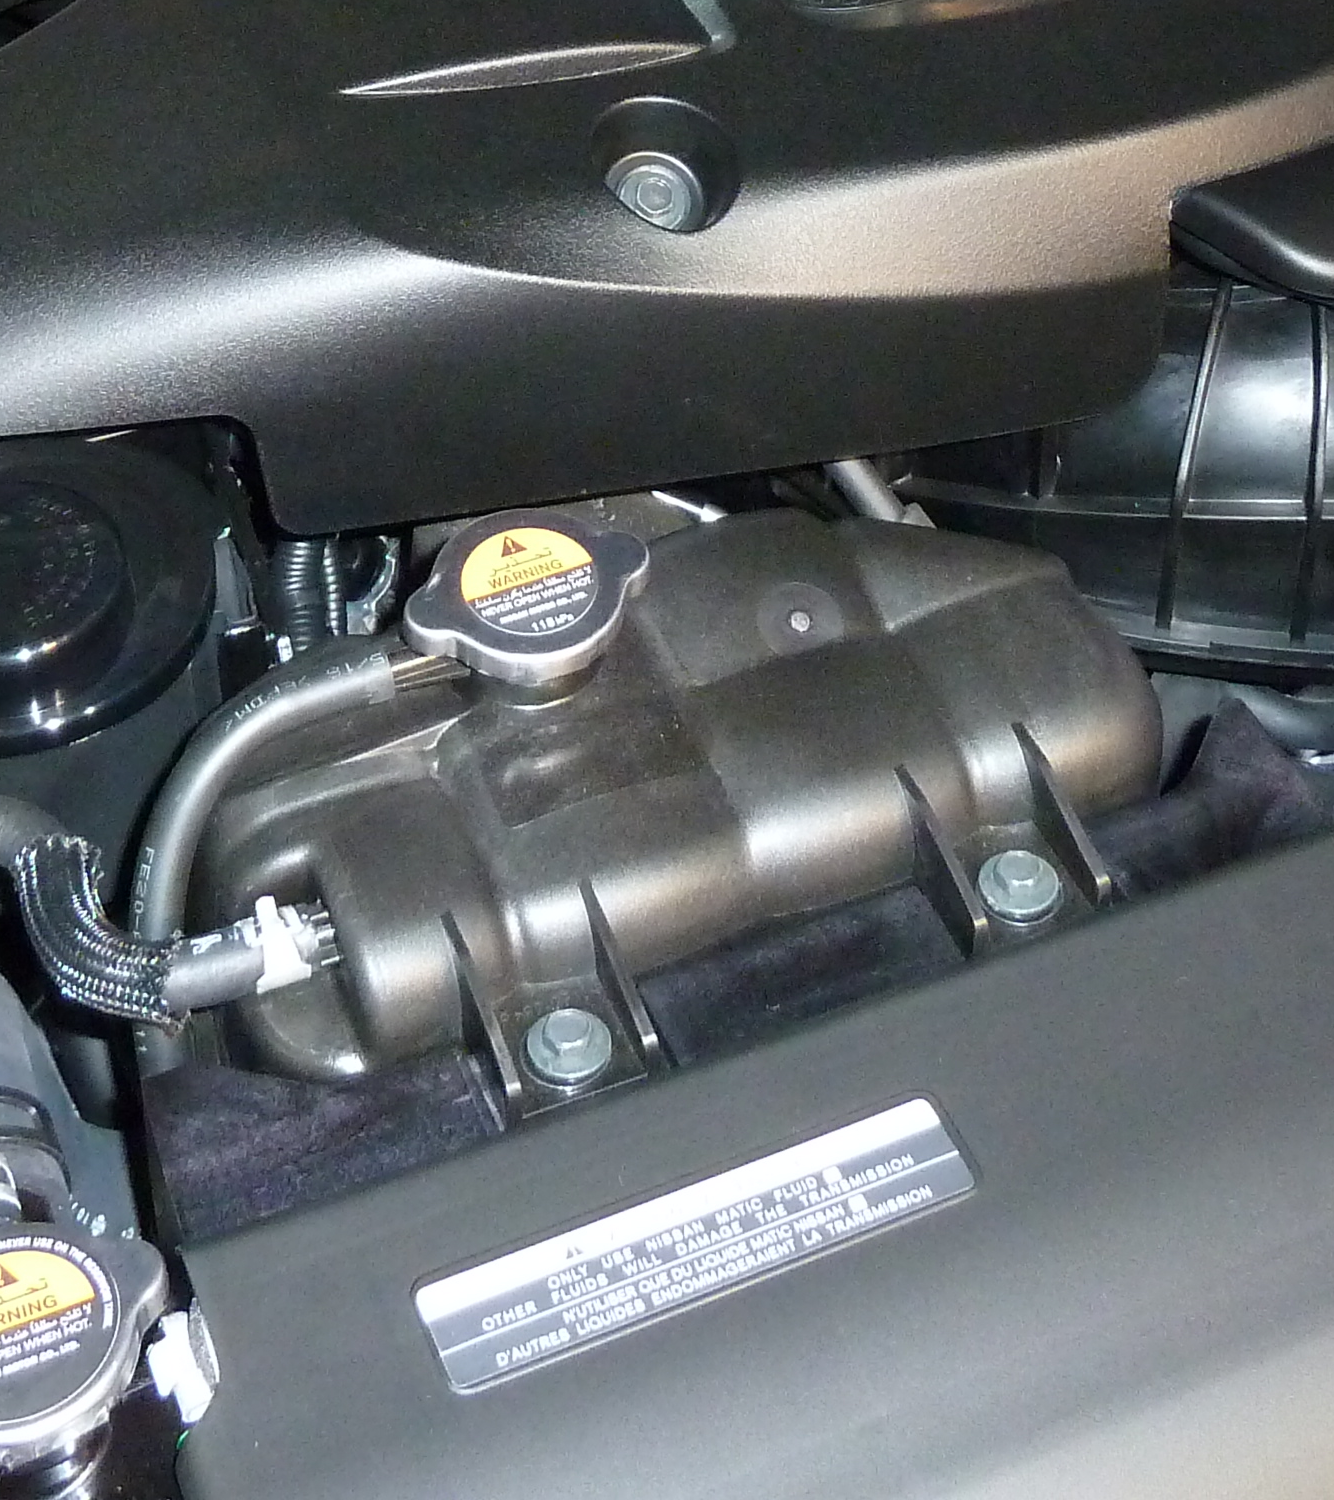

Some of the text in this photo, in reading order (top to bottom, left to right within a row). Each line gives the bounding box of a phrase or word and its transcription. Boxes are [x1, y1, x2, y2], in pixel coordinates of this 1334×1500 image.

[481, 601, 512, 616] NEVER
[513, 593, 540, 607] OPEN
[541, 583, 570, 598] WHEN
[487, 559, 564, 590] WARNING
[481, 1300, 537, 1331] OTHER
[550, 1273, 609, 1304] FLUIDS
[621, 1254, 663, 1277] WILL
[675, 1222, 743, 1257] DAMAGE
[754, 1204, 788, 1226] THE
[799, 1153, 915, 1207] TRANSMISSION
[495, 1327, 571, 1367] D'AUTRES
[575, 1297, 646, 1336] LIQUIDES
[650, 1238, 797, 1305] ENDOMMAGERAIENT
[801, 1227, 822, 1247] LA
[825, 1184, 933, 1241] TRANSMISSION
[547, 1176, 818, 1290] ONLY USE NISSAN MATIC FLUID
[562, 1204, 846, 1325] N'UTILISER QUE DU LIQUIDE MATIC NISSAN
[24, 1328, 61, 1349] WHEN
[62, 1317, 92, 1335] HOT.
